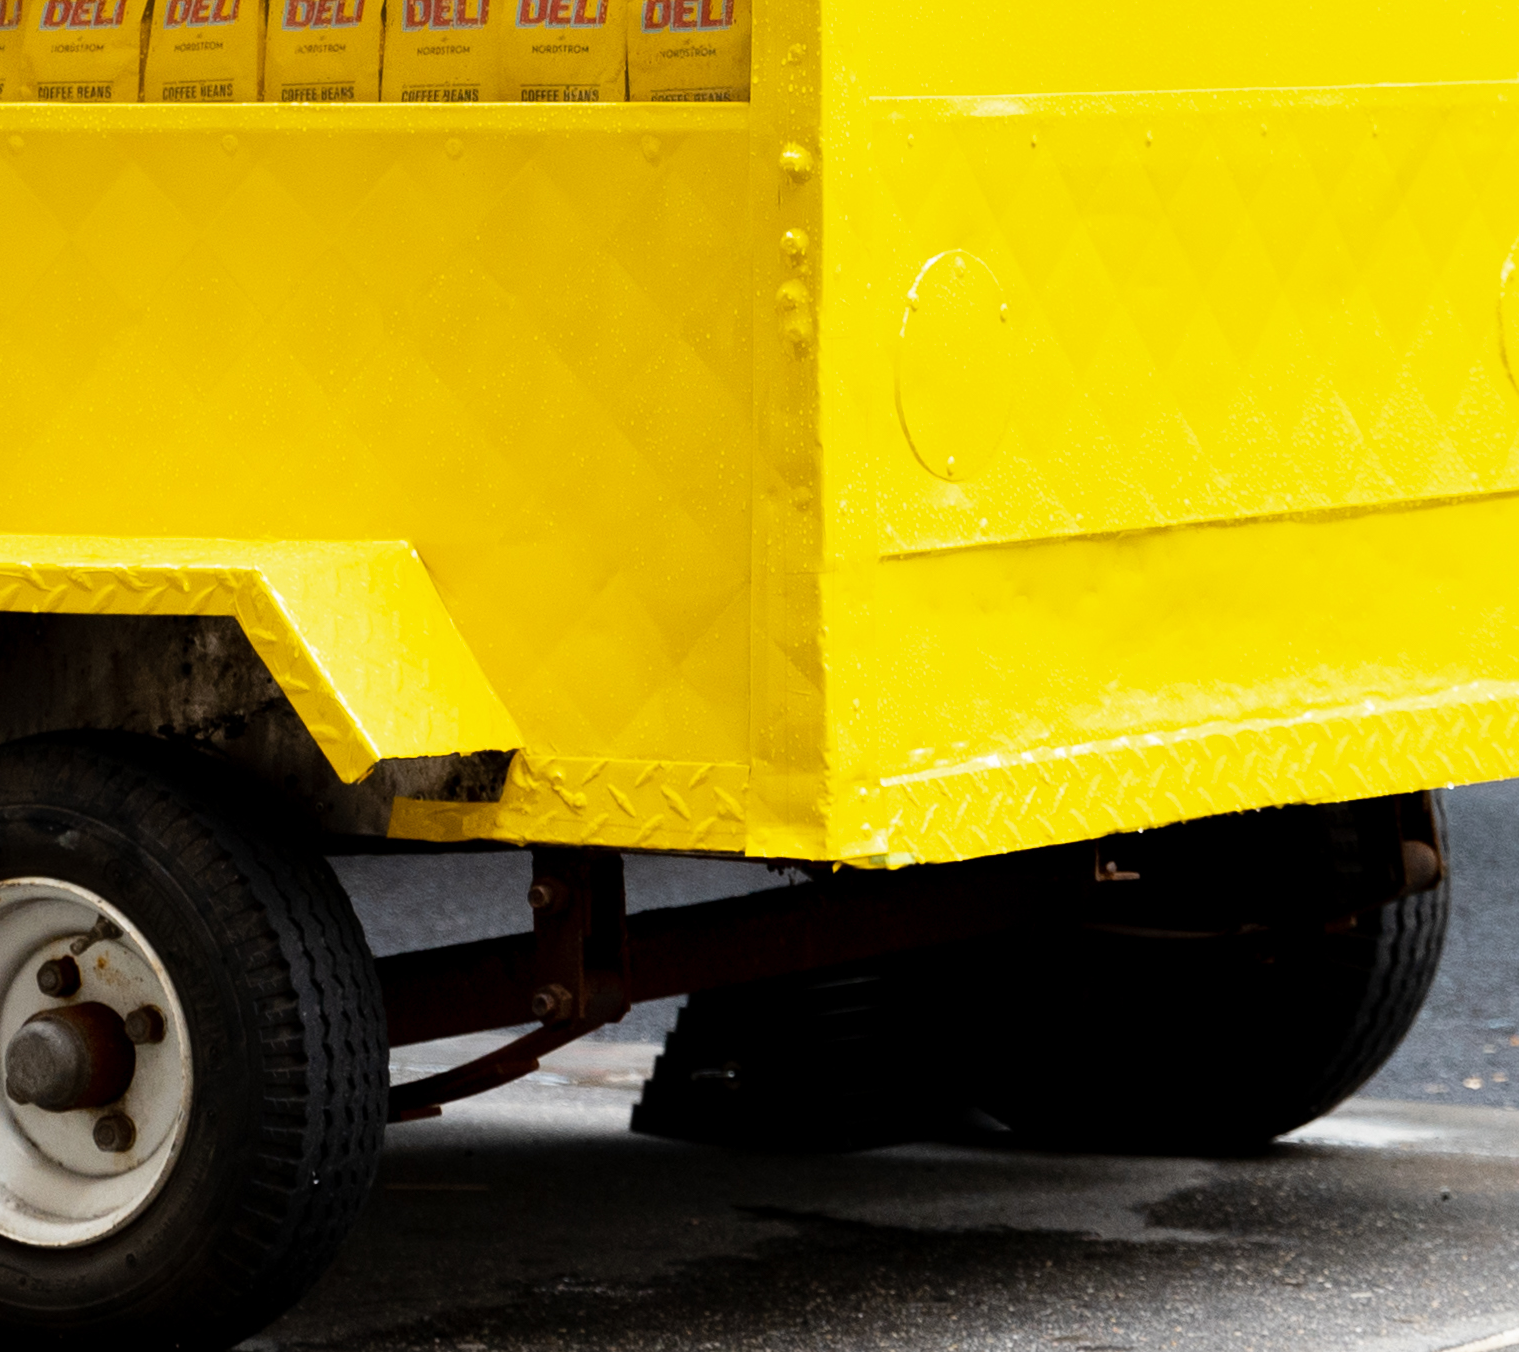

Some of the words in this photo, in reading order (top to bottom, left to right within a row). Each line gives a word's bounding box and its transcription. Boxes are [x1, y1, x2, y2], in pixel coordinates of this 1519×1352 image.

[417, 45, 470, 56] NORDSTROM
[532, 45, 589, 53] NORDSTROM
[38, 86, 74, 100] COFFEE
[77, 86, 112, 99] BEANS
[163, 87, 197, 101] COFFEE
[200, 83, 233, 97] BEANS
[281, 87, 318, 102] COFFEE
[321, 86, 355, 101] BEANS
[401, 88, 441, 102] COFFEE
[444, 88, 479, 102] BEANS
[521, 89, 559, 102] COFFEE
[563, 88, 599, 102] BEANS
